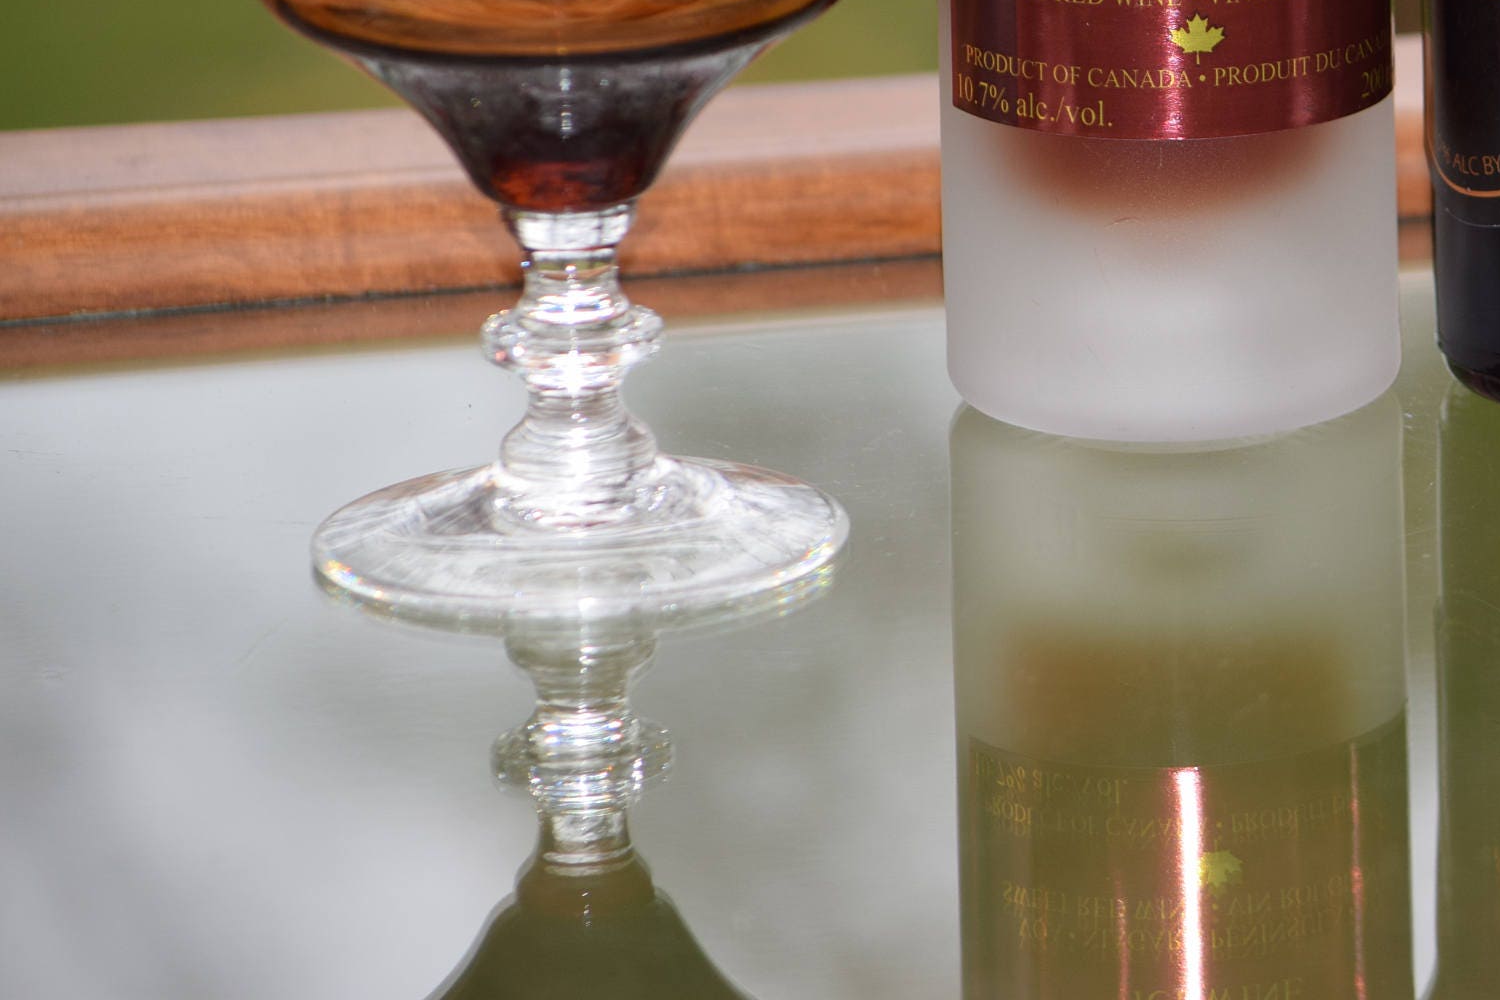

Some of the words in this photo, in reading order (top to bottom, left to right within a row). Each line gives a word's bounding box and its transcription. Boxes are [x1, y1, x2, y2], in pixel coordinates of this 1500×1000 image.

[965, 44, 1047, 81] PRODUCT
[1053, 64, 1081, 85] OF
[1087, 67, 1192, 89] CANADA
[1215, 55, 1310, 87] PRODUIT
[1316, 47, 1340, 73] DU
[957, 73, 1009, 113] 10.7%
[1017, 93, 1113, 127] alc./vol.
[1452, 153, 1479, 176] ALC
[1481, 154, 1500, 176] BY
